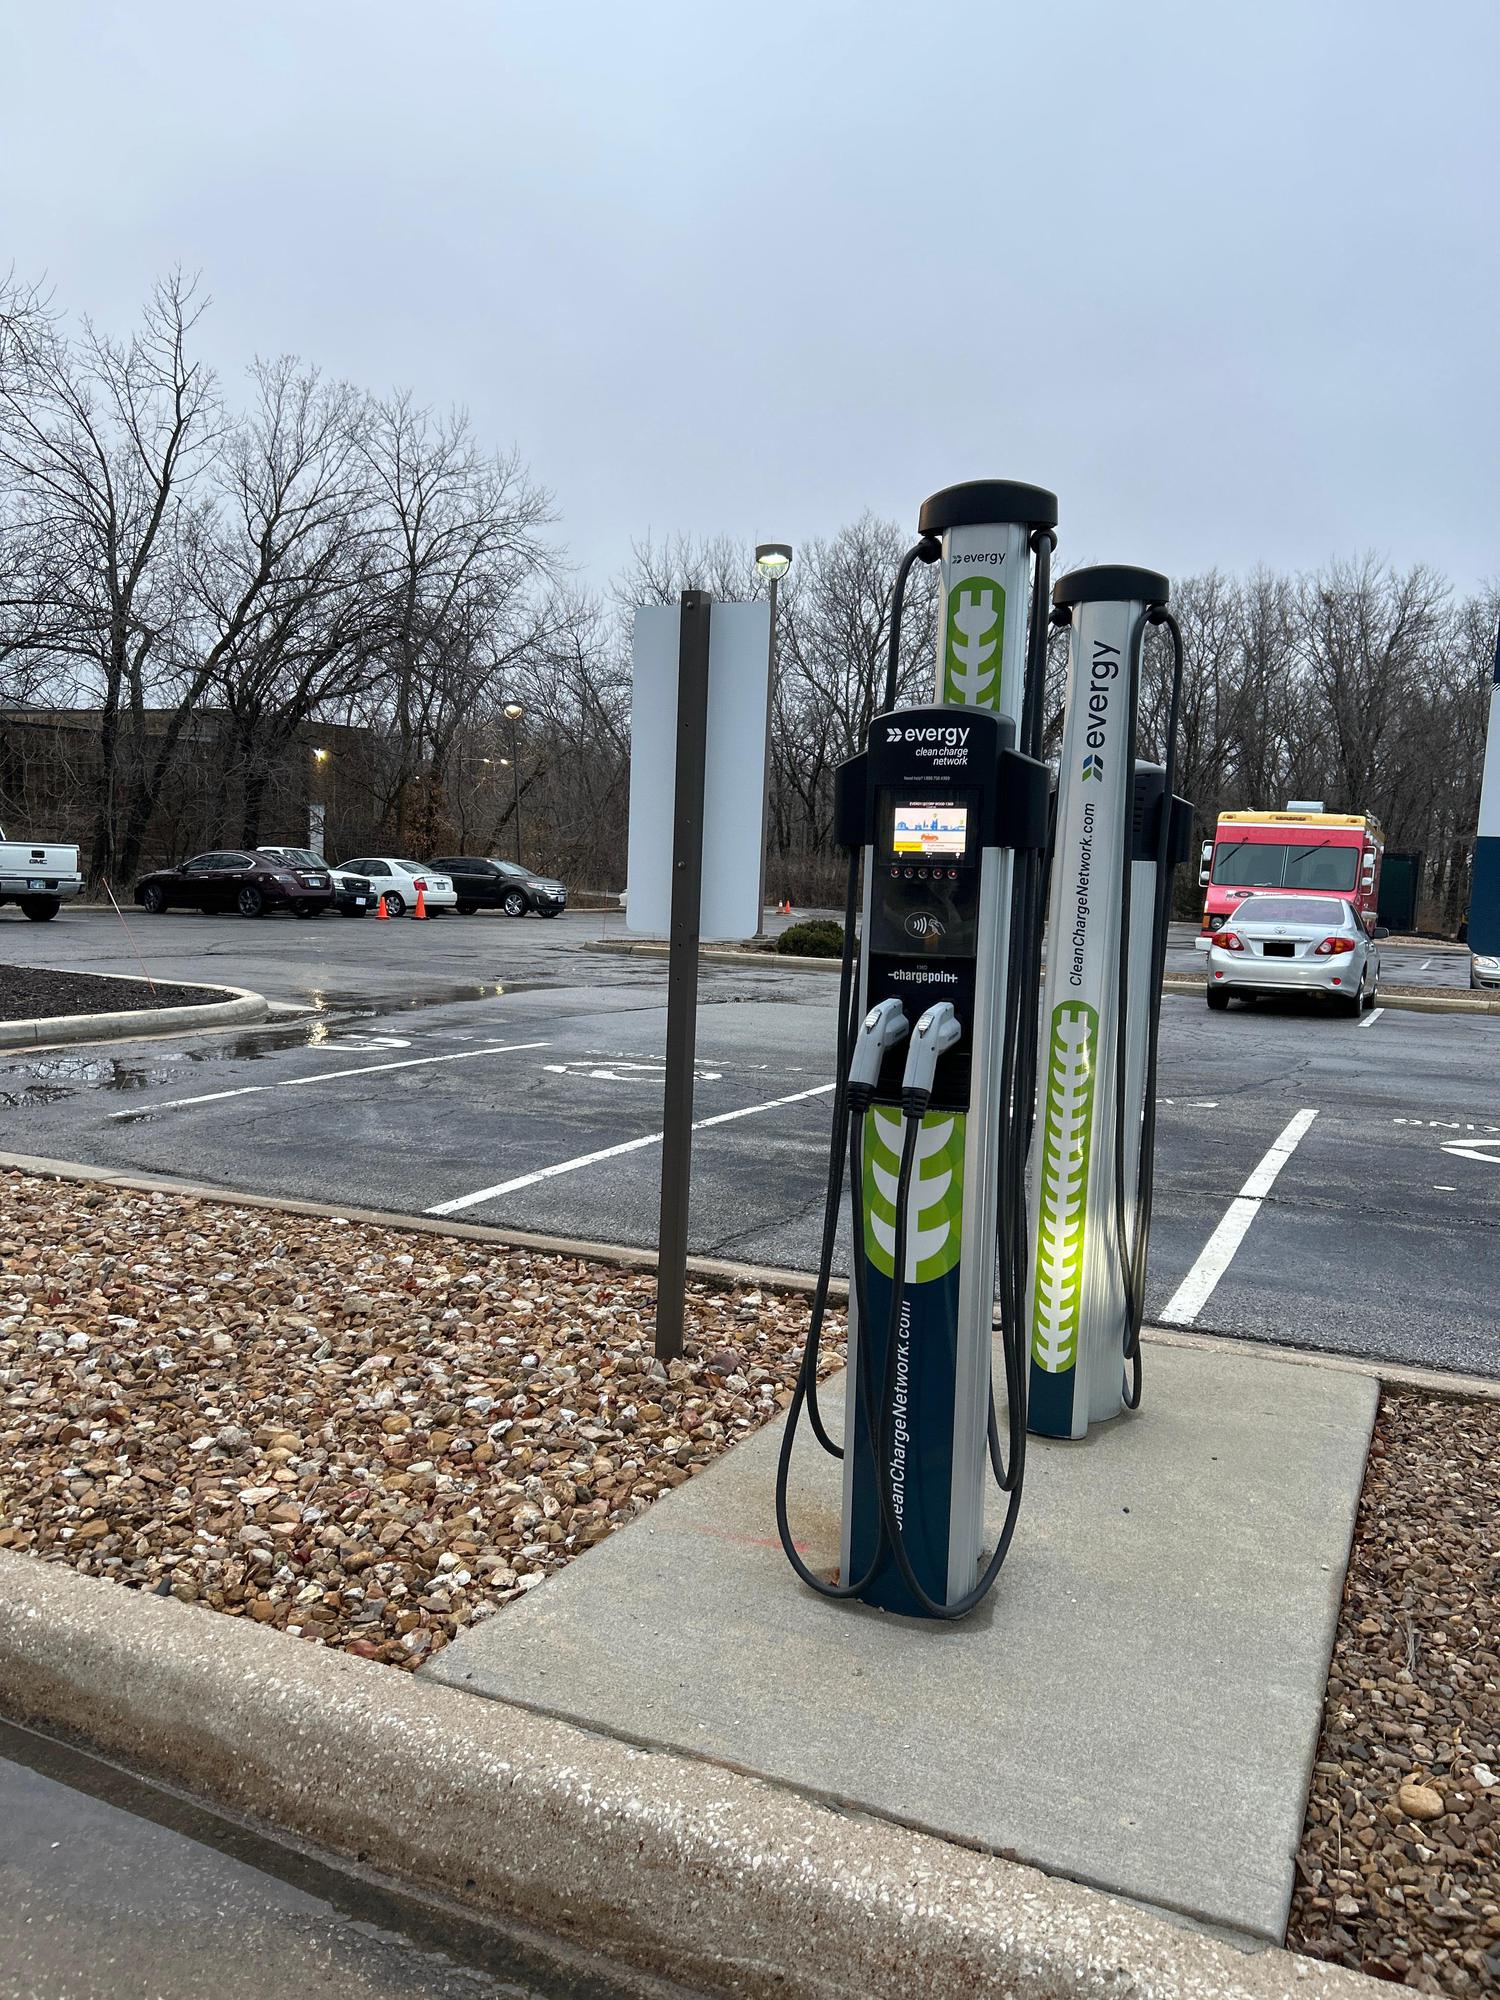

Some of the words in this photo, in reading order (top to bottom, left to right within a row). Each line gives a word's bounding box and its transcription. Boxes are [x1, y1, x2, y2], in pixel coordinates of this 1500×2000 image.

[963, 551, 1006, 565] evergy
[1086, 640, 1121, 749] evergy
[904, 727, 970, 746] evergy
[915, 747, 938, 757] clean
[938, 747, 969, 758] charge
[932, 756, 968, 766] network
[1069, 802, 1095, 987] CleanChargeNetwork.com
